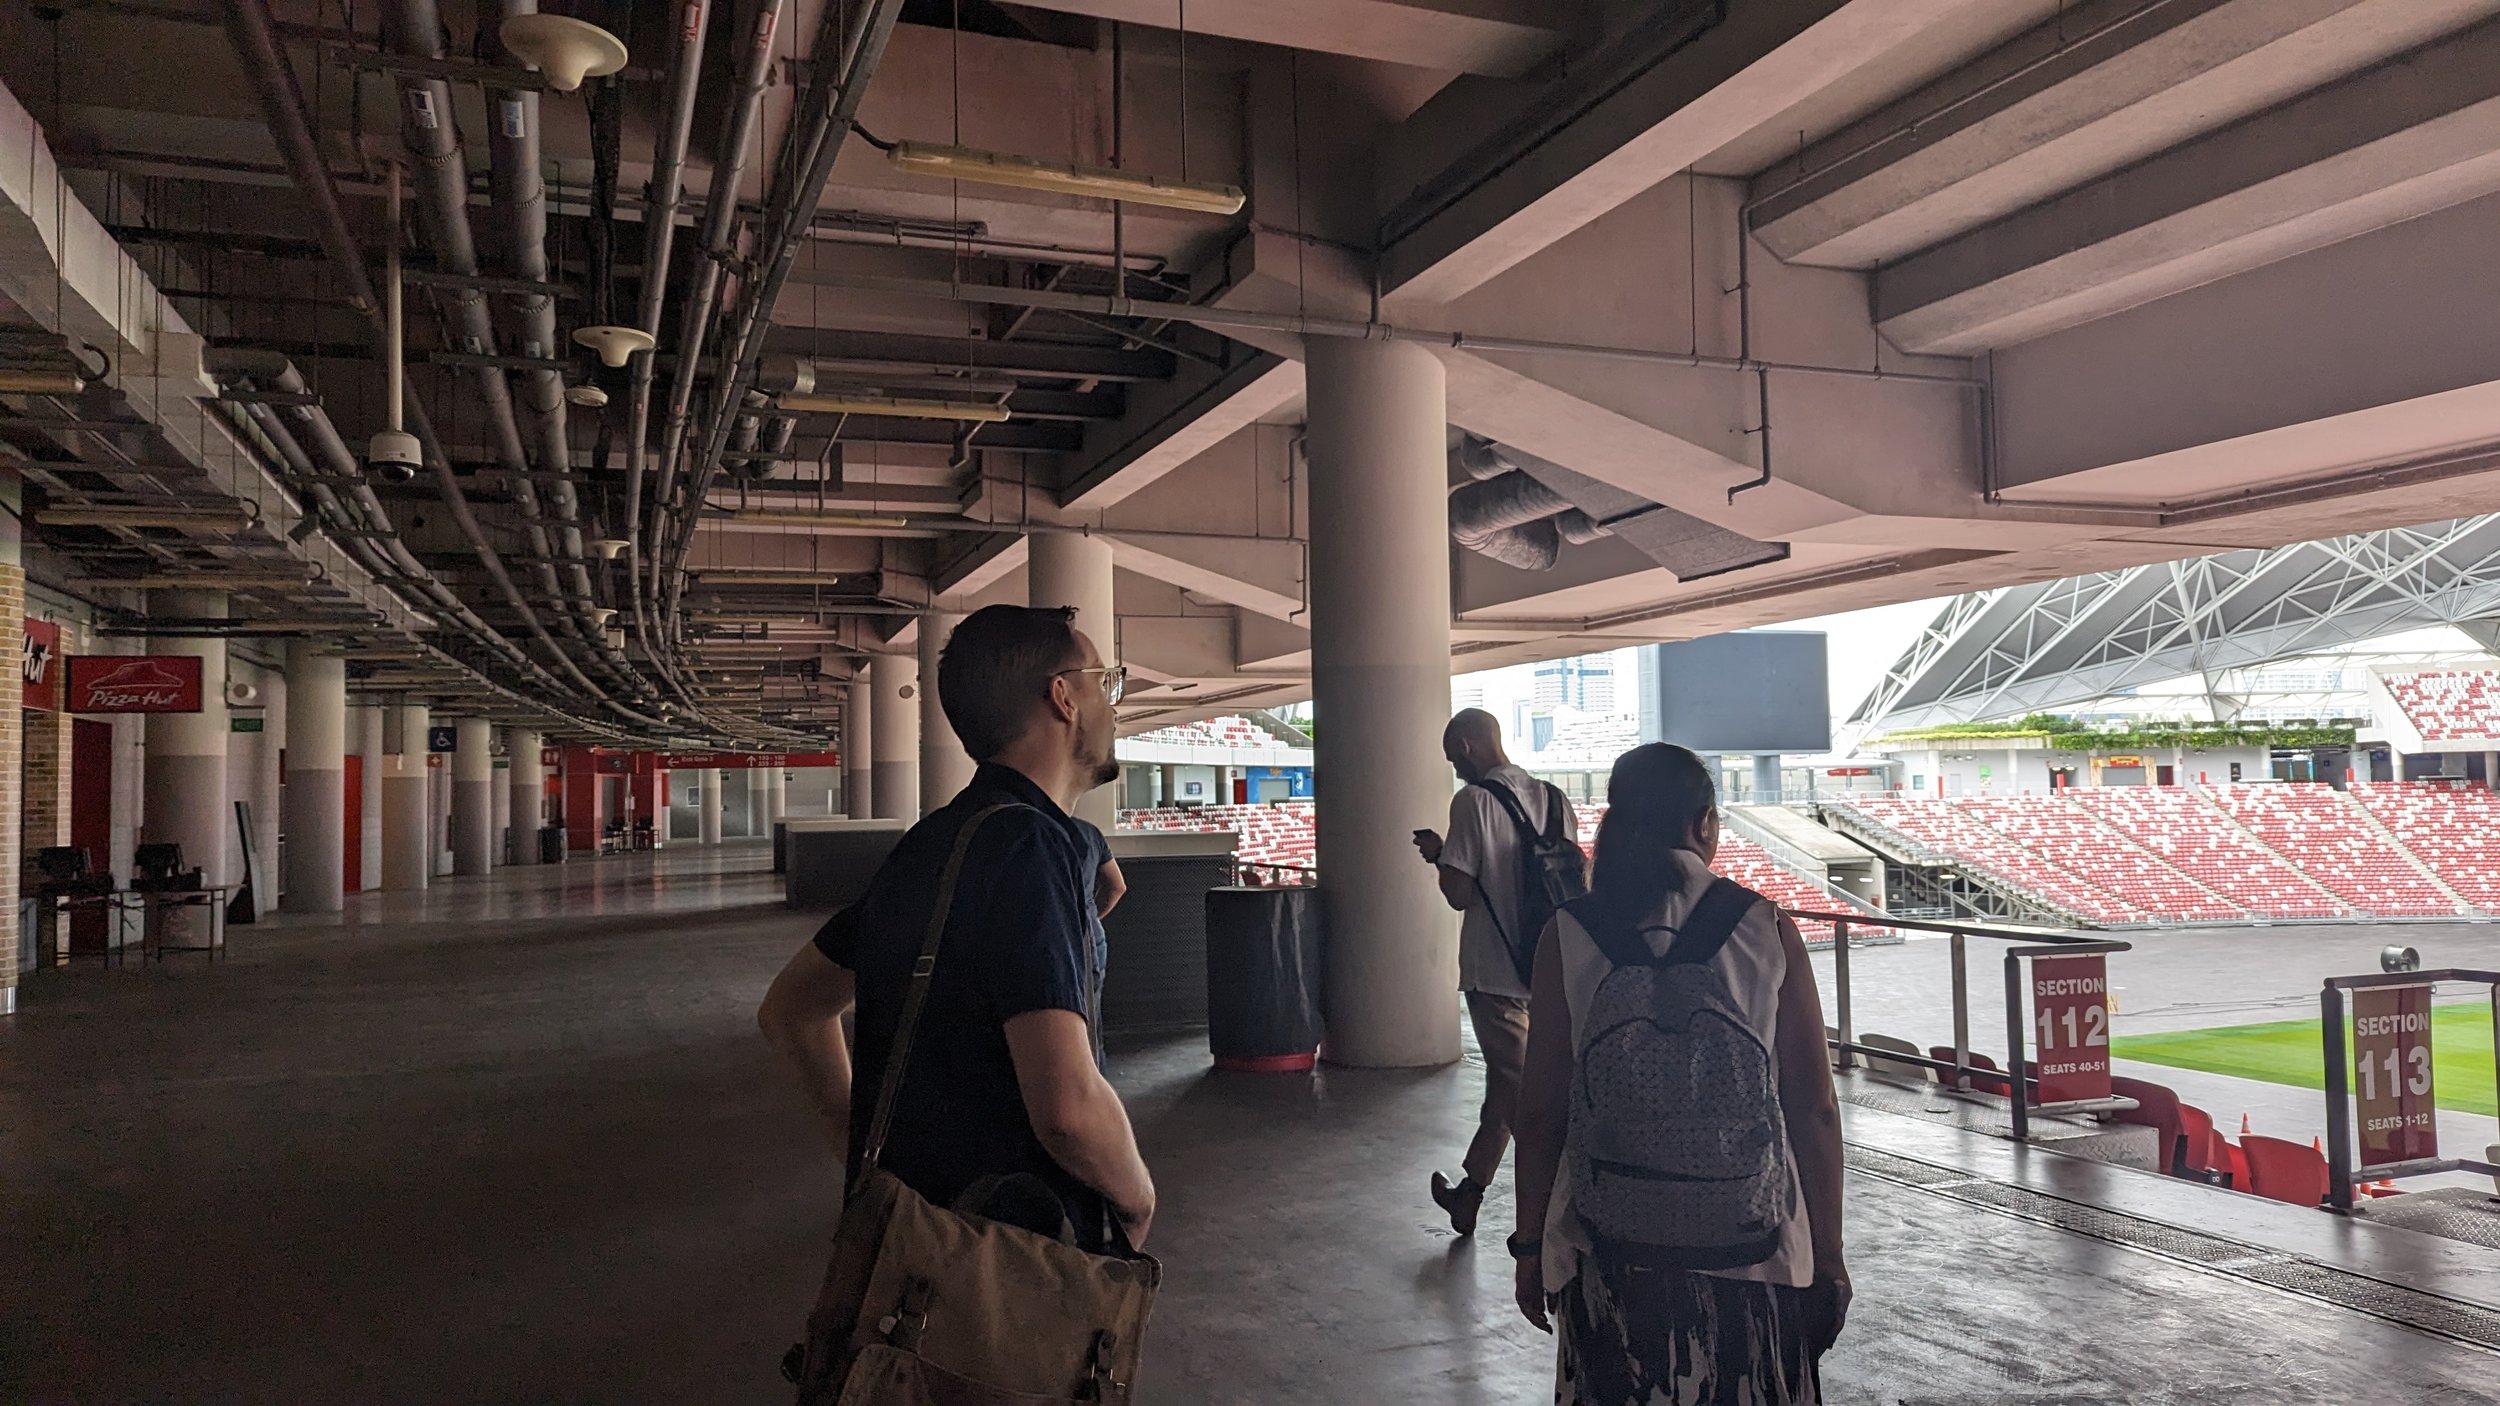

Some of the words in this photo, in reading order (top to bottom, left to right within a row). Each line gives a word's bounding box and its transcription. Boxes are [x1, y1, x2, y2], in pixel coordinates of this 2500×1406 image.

[23, 632, 53, 684] Hut
[87, 690, 139, 707] Pizza
[142, 690, 180, 705] Hut
[2037, 978, 2104, 996] SECTION
[2038, 1005, 2107, 1049] 112
[2357, 1013, 2429, 1037] SECTION
[2043, 1063, 2077, 1075] SEATS
[2079, 1061, 2105, 1072] 40-51
[2358, 1046, 2431, 1101] 113
[2367, 1116, 2403, 1131] SEATS
[2405, 1113, 2429, 1126] 1-12
